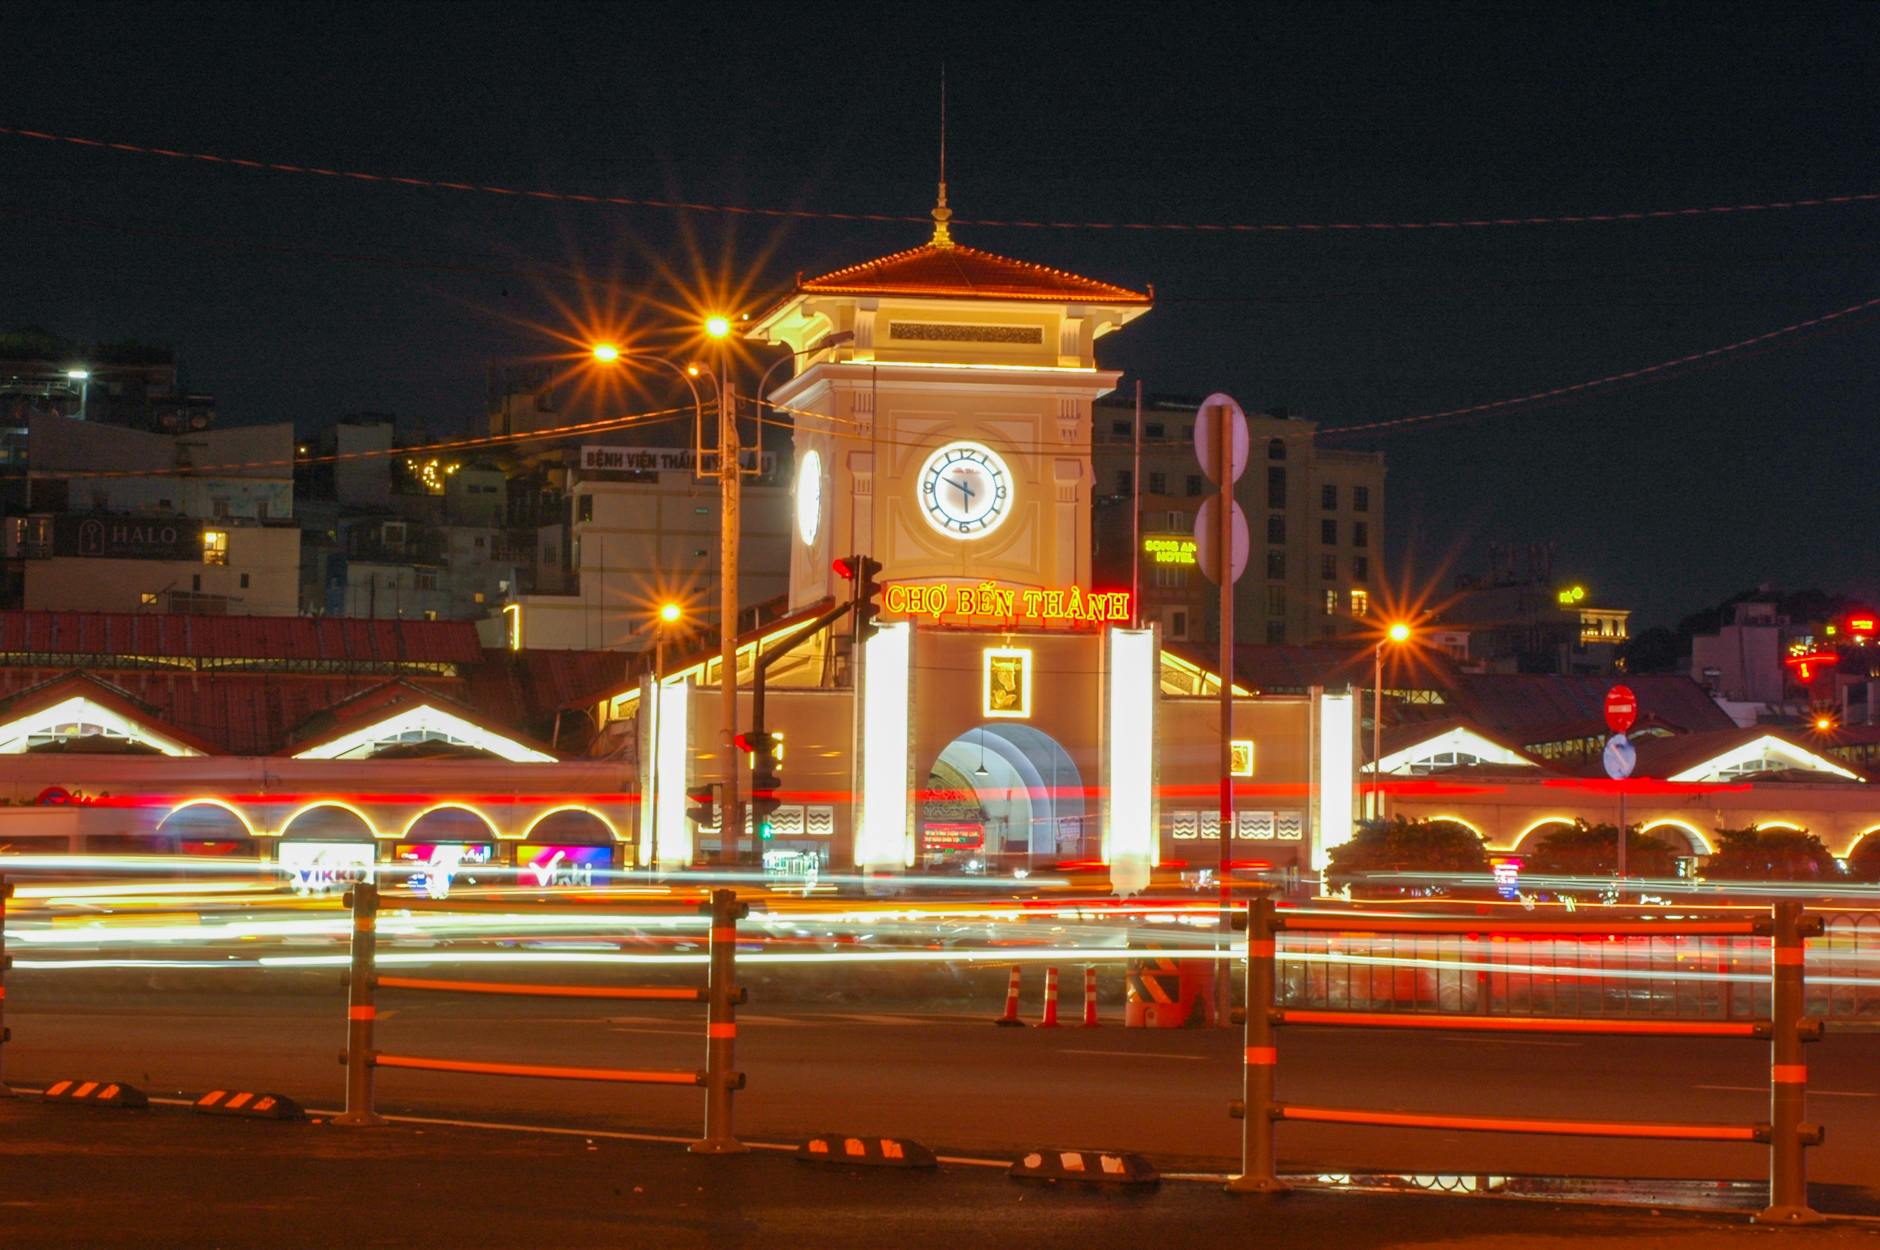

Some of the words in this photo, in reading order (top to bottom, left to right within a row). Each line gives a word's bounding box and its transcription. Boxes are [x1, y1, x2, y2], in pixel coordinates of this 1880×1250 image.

[587, 449, 623, 468] BỆNH
[626, 450, 657, 470] VIỆN
[958, 448, 976, 459] 12
[923, 481, 934, 494] 9
[997, 485, 1007, 499] 3
[958, 522, 970, 534] 6
[112, 526, 177, 544] HALO
[1156, 551, 1196, 563] HOTEL
[885, 583, 947, 618] CHỢ
[956, 580, 1014, 617] BẾN
[1023, 585, 1130, 621] THÀNH
